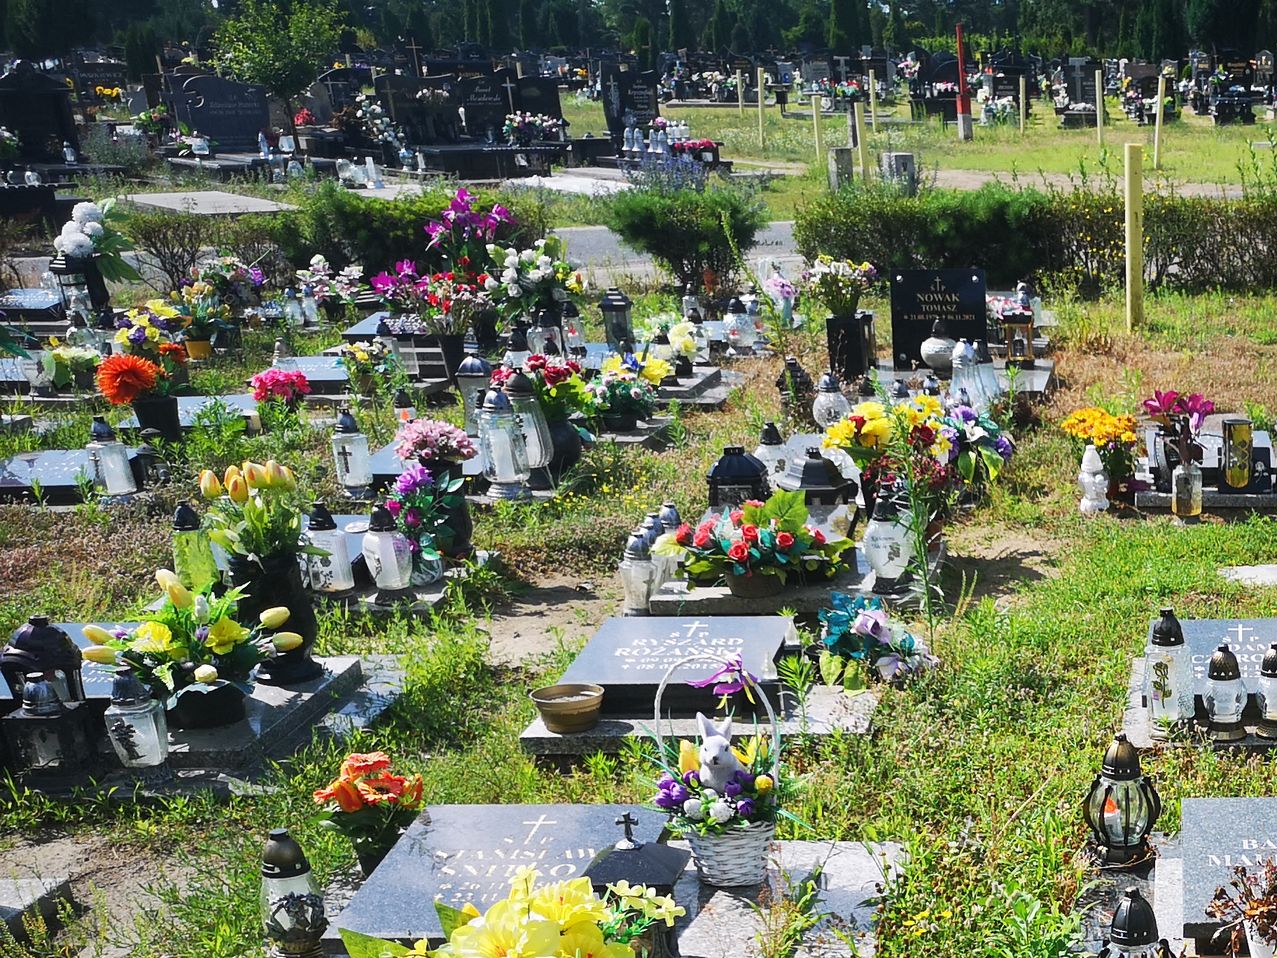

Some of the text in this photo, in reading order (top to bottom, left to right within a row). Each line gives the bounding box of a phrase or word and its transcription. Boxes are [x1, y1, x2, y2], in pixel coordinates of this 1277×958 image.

[917, 293, 960, 302] NOWAK
[632, 638, 744, 646] RYSZARD
[1212, 644, 1273, 652] DAM
[437, 863, 577, 877] SNITO
